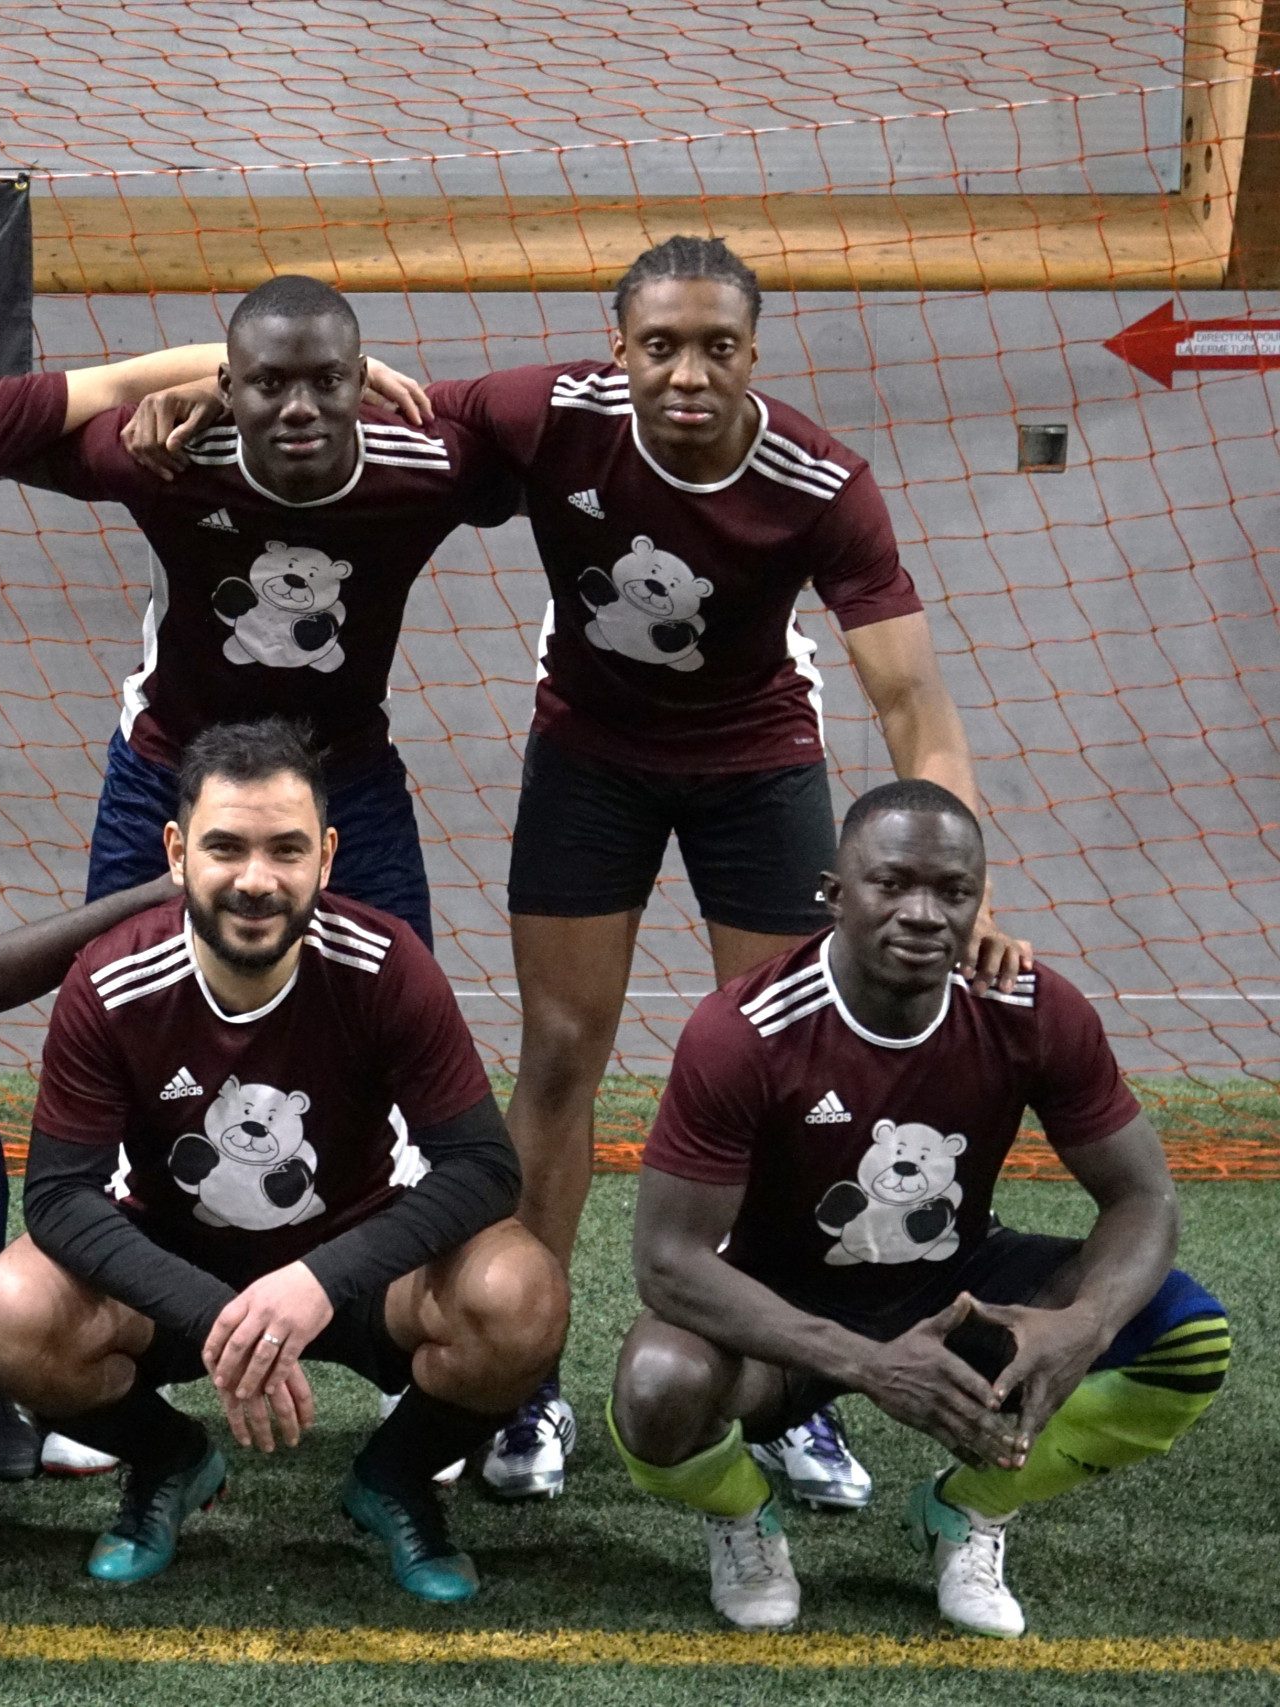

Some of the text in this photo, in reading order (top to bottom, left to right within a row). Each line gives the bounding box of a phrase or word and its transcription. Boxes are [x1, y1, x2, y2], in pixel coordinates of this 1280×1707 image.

[1196, 332, 1280, 342] DIRECTION POU
[1178, 344, 1192, 354] LA
[1194, 344, 1257, 354] FERMETURE
[1261, 344, 1276, 354] DU
[567, 494, 605, 520] adidas
[159, 1085, 204, 1100] adidas
[804, 1112, 852, 1125] adidas
